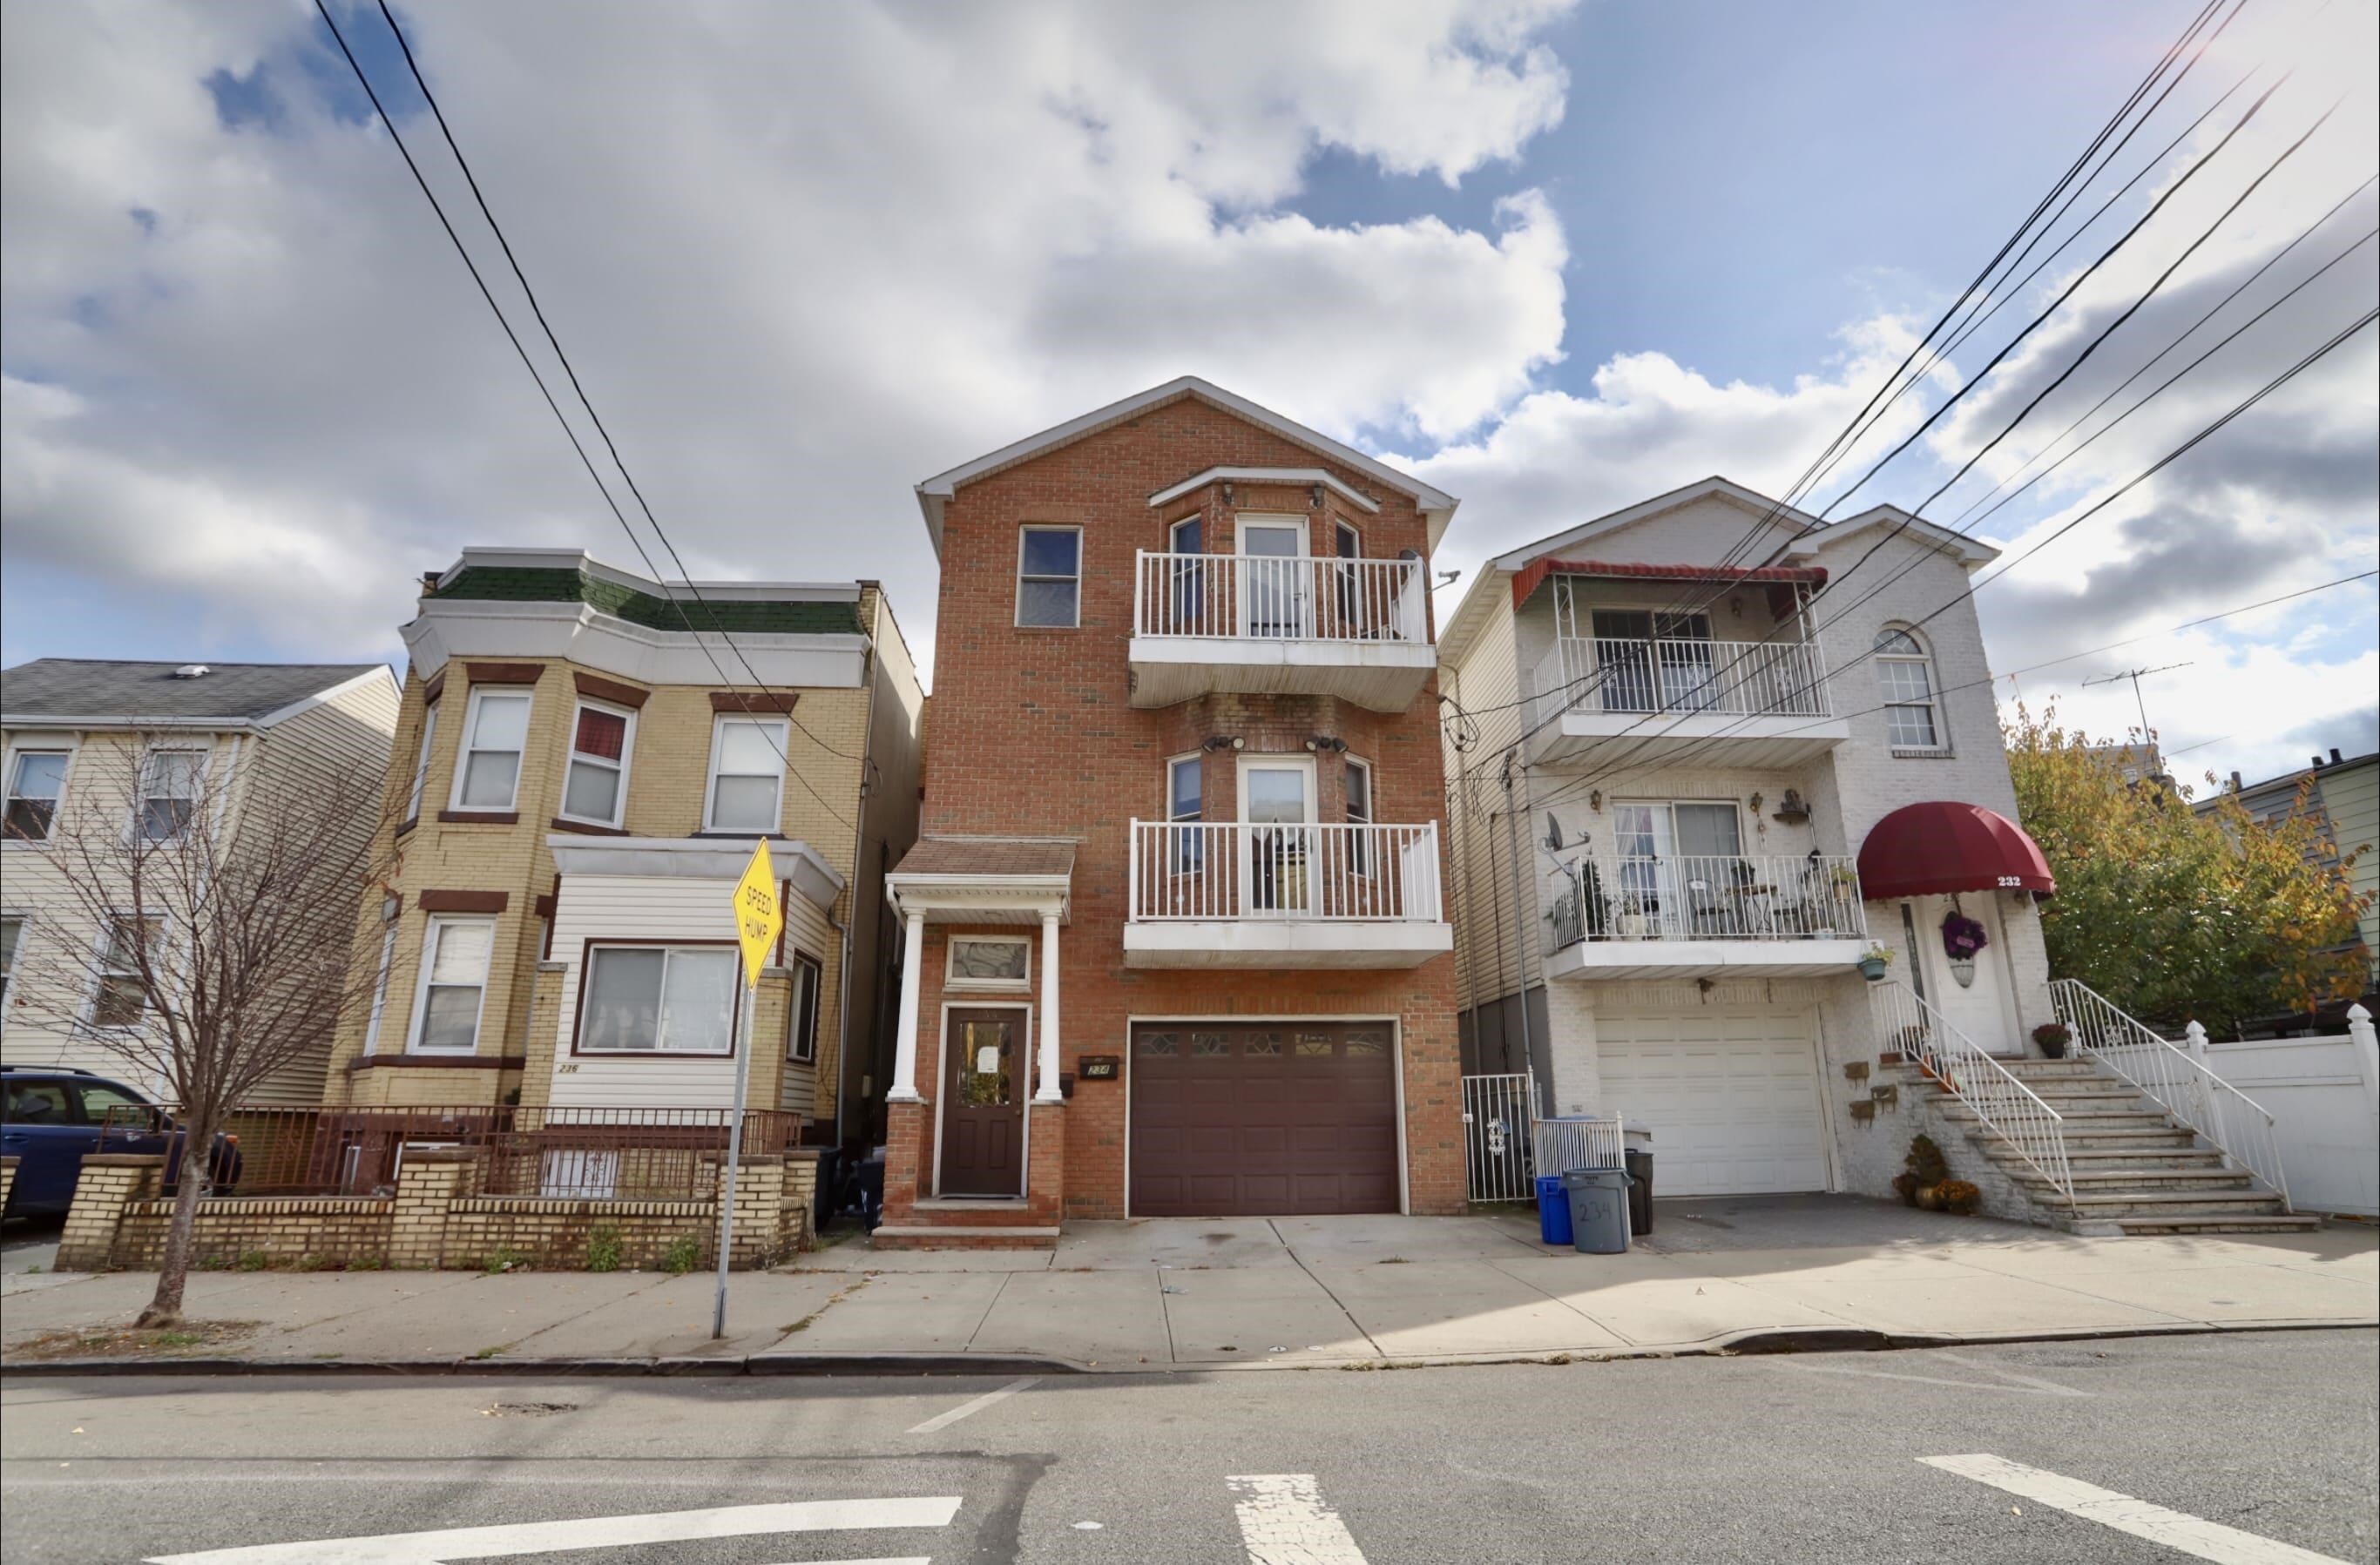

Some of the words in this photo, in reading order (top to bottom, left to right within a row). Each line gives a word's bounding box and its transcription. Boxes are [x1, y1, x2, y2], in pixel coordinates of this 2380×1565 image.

[1997, 875, 2021, 887] 232
[746, 885, 772, 916] SPEED
[744, 914, 768, 941] HUMP
[558, 1064, 579, 1073] 236
[1579, 1200, 1611, 1222] 234
